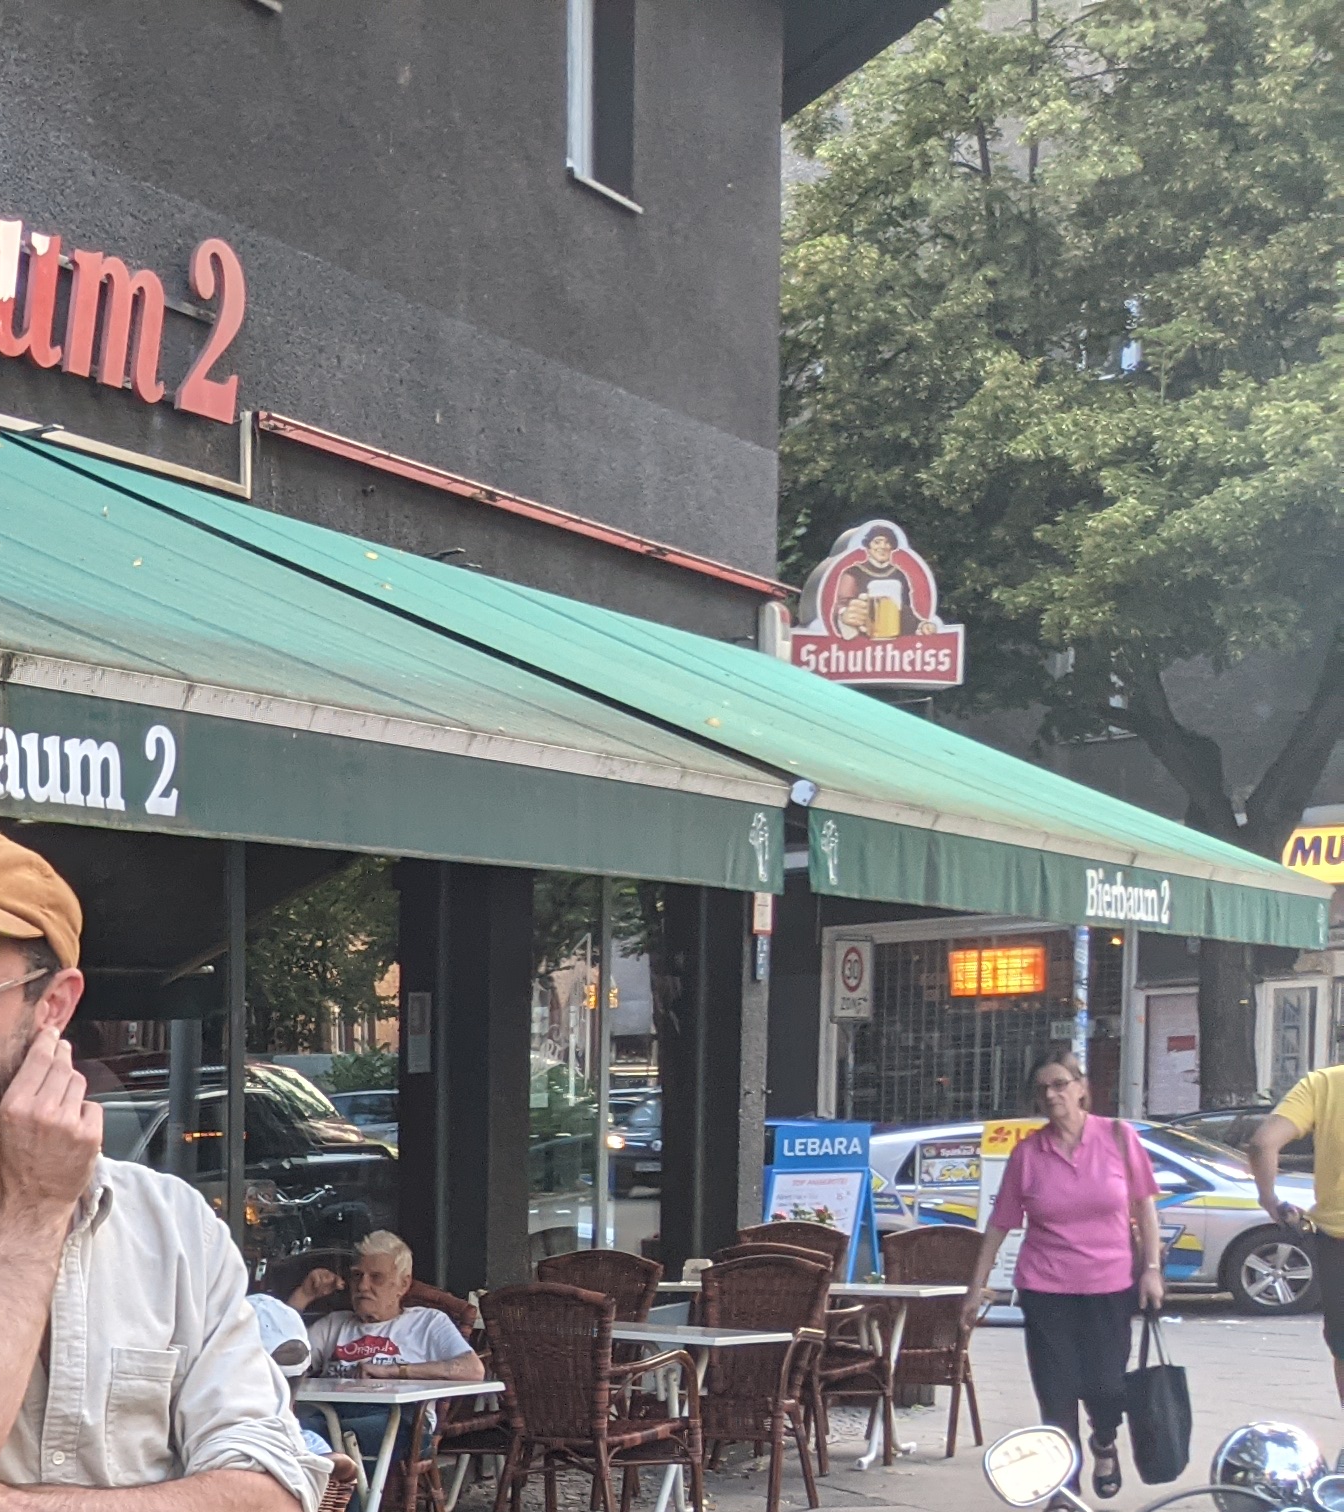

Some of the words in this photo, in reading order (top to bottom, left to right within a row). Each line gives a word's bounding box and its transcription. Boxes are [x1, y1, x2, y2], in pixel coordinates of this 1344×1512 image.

[174, 237, 249, 424] 2
[799, 642, 953, 675] Schultheiss
[143, 724, 179, 818] 2
[1085, 868, 1157, 921] Bierbaum
[1159, 879, 1171, 925] 2
[844, 957, 861, 981] 30
[783, 1136, 863, 1157] LEBARA
